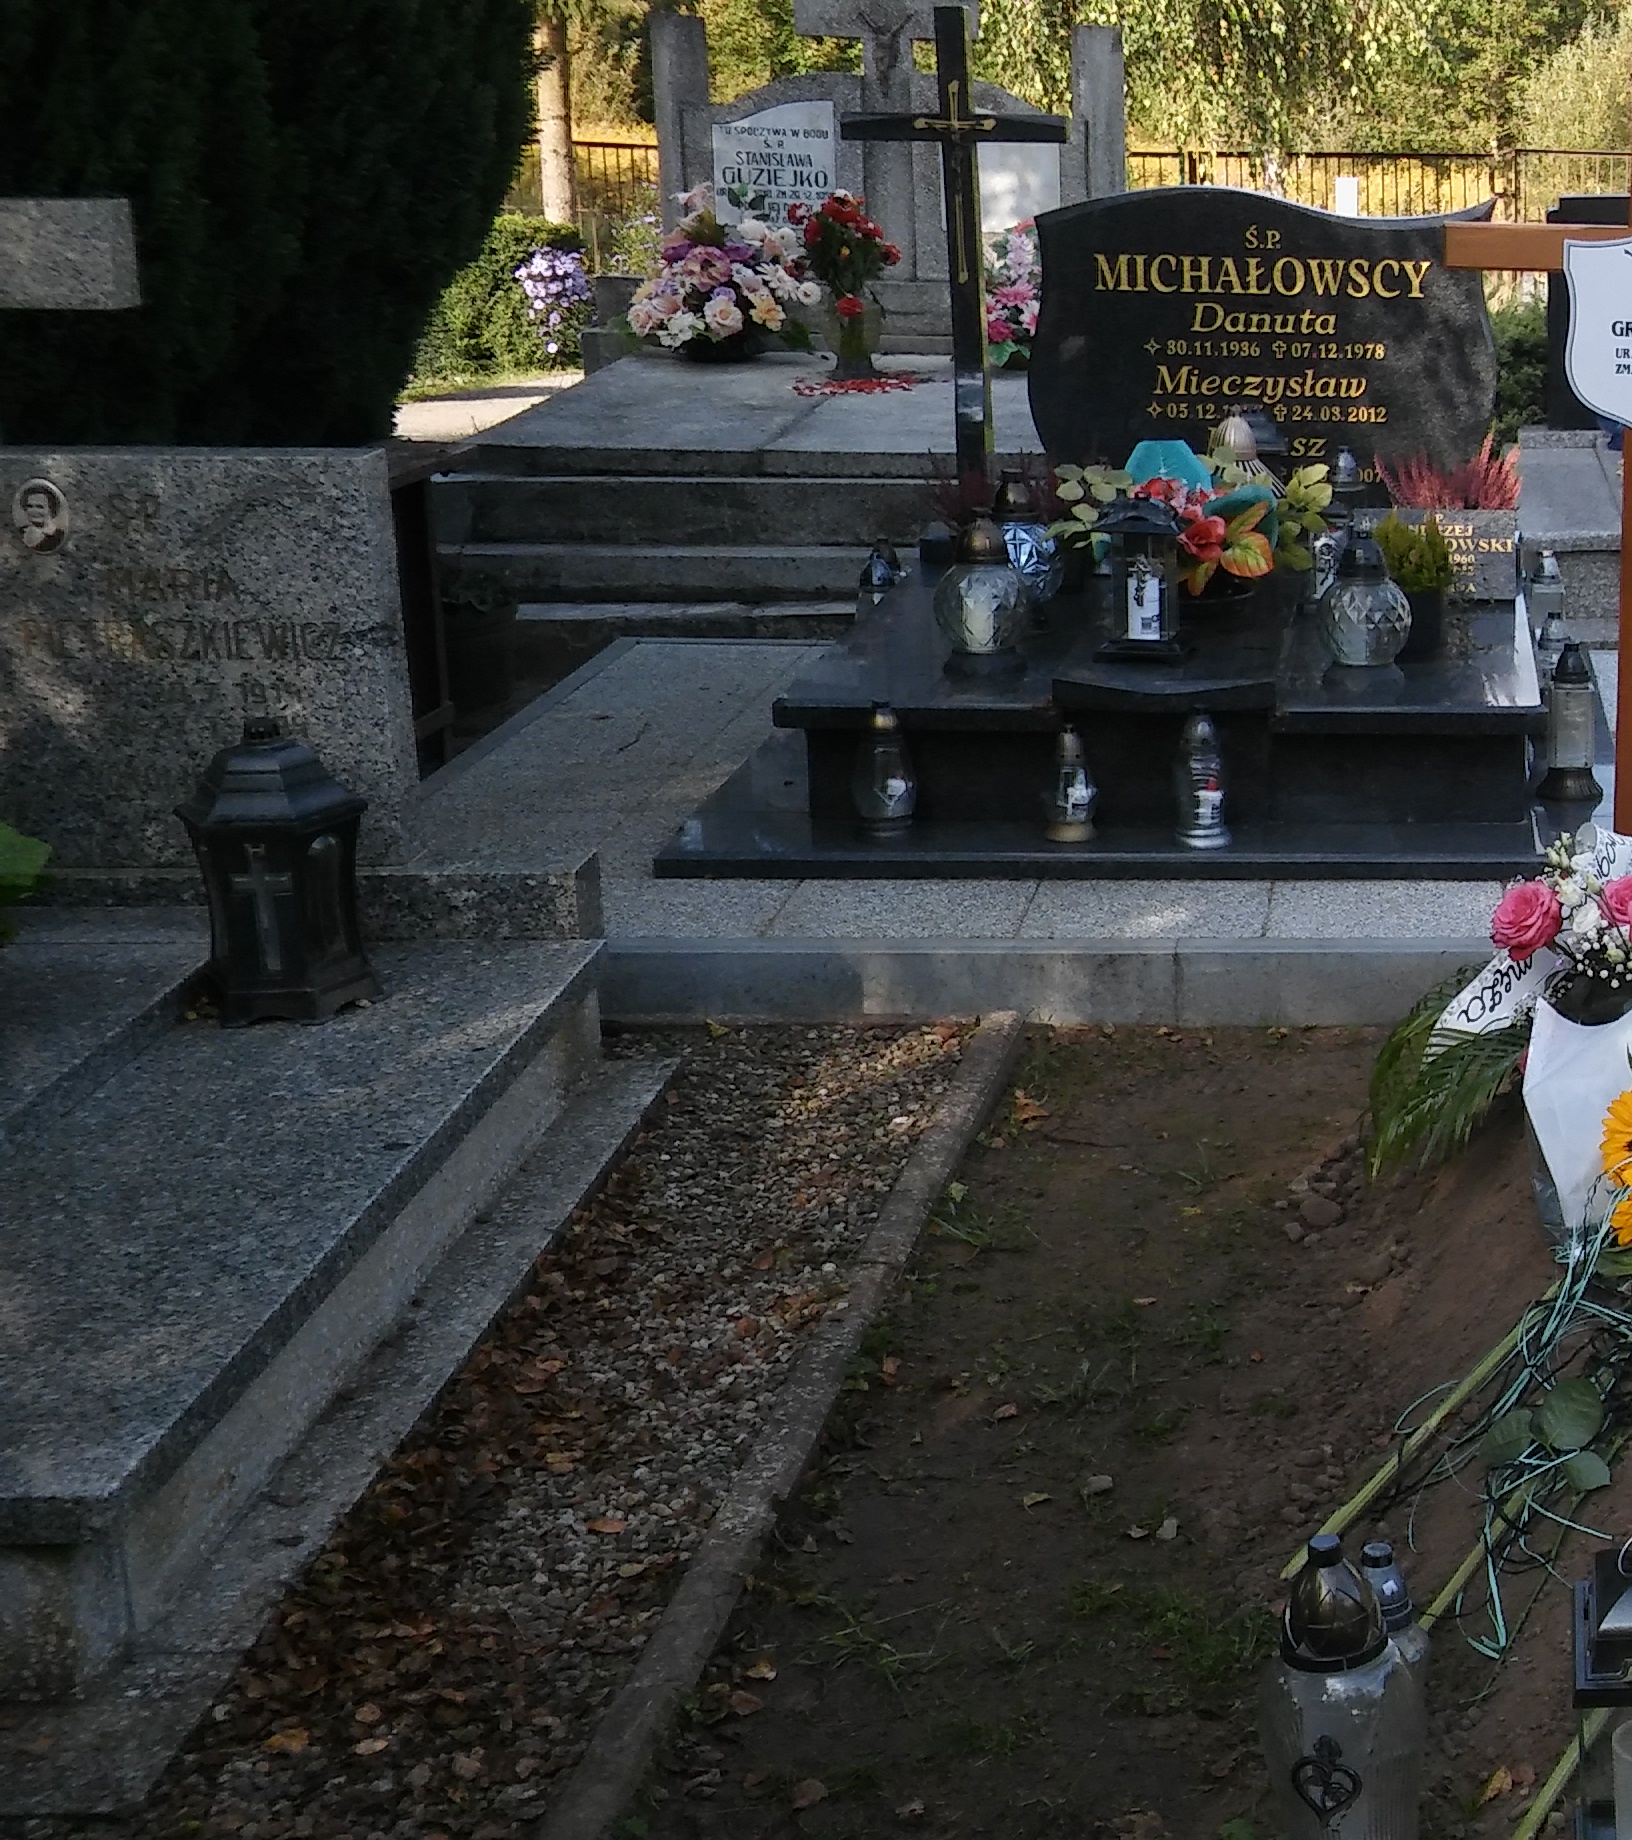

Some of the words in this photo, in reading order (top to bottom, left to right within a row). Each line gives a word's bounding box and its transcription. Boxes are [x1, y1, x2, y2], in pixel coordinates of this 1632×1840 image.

[734, 127, 787, 138] SPOCZYWA
[790, 128, 799, 139] W
[736, 151, 813, 168] STANISŁAWA
[722, 167, 828, 188] GUZIEJKO
[1094, 253, 1431, 298] MICHAŁOWSCY
[1190, 302, 1337, 335] Danuta
[1167, 341, 1261, 358] 30.11.1936
[1291, 343, 1386, 361] 07.12.1978
[1153, 364, 1367, 403] Mieczysław
